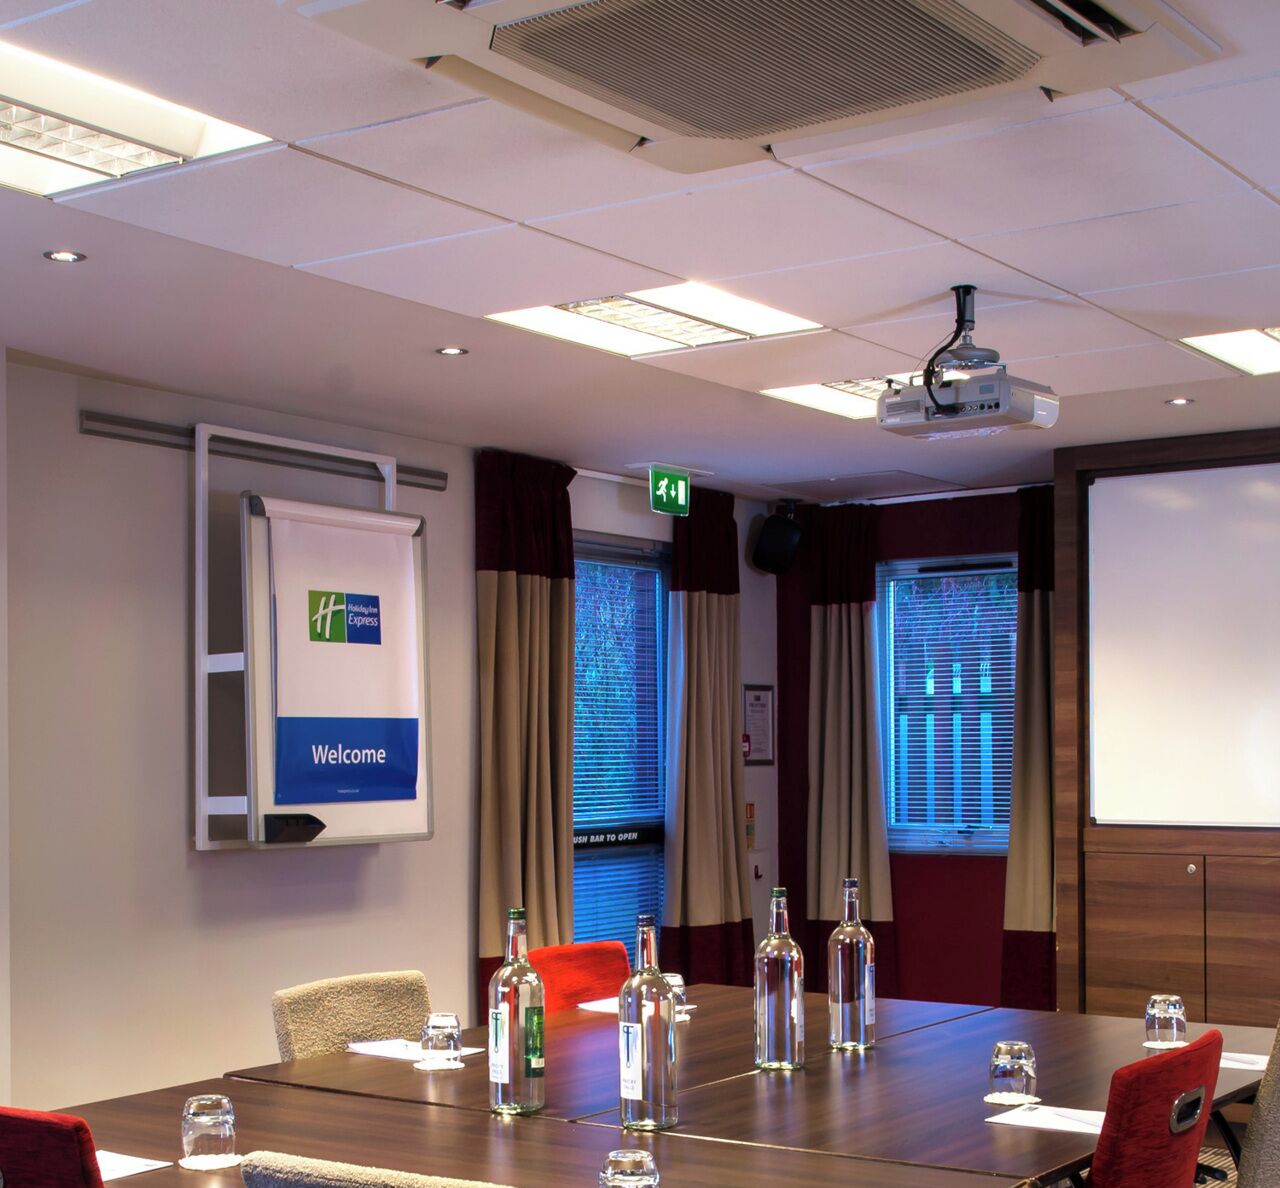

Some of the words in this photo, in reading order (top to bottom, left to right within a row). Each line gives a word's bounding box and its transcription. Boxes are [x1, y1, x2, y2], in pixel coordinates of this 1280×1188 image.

[348, 603, 370, 615] Holiday
[348, 613, 379, 628] Express
[311, 743, 386, 764] Welcome
[573, 835, 588, 844] USH
[589, 834, 605, 843] BAR
[606, 833, 617, 842] TO
[617, 831, 638, 841] OPEN
